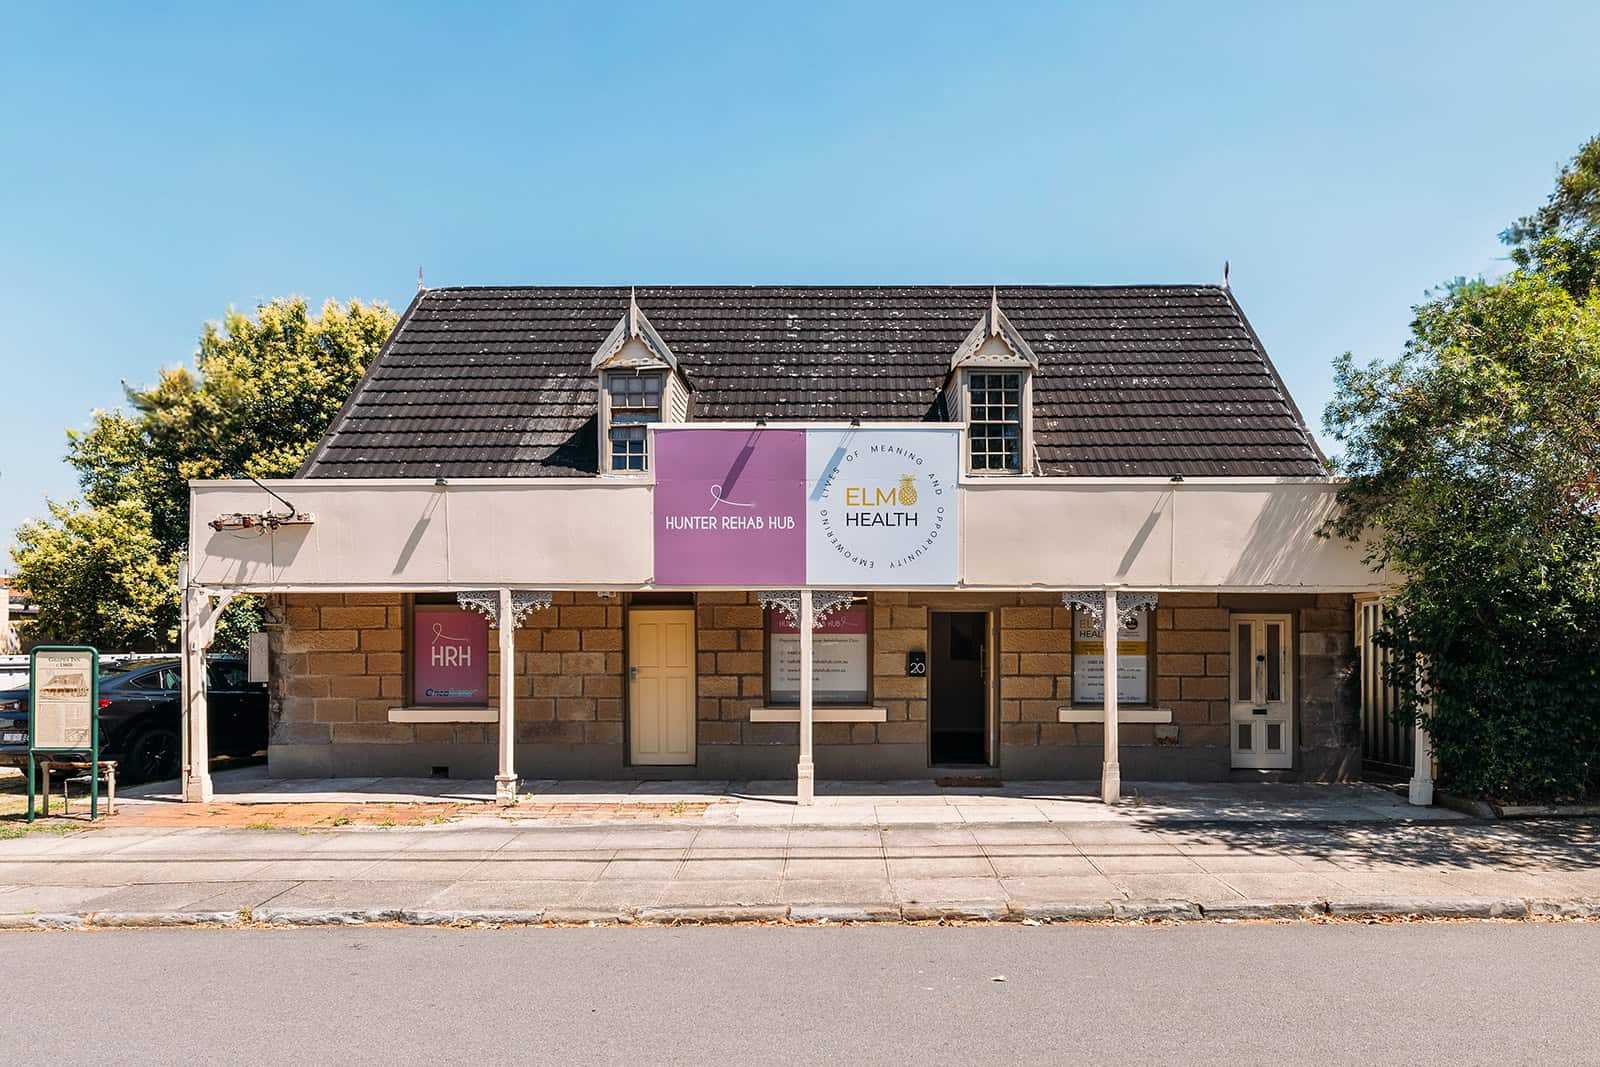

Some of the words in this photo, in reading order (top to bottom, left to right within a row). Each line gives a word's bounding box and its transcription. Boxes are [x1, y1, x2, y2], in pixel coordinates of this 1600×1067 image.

[846, 450, 860, 462] OF
[870, 445, 923, 466] MEANING
[821, 466, 840, 498] LIVES
[928, 472, 943, 496] AND
[665, 516, 718, 530] HUNTER
[721, 516, 764, 530] REHAB
[768, 516, 796, 530] HUB
[846, 512, 918, 527] HEALTH
[820, 509, 874, 569] EMPOWERING
[889, 506, 945, 569] OPPORTUNITY
[431, 645, 471, 667] HRH
[910, 662, 926, 674] 20
